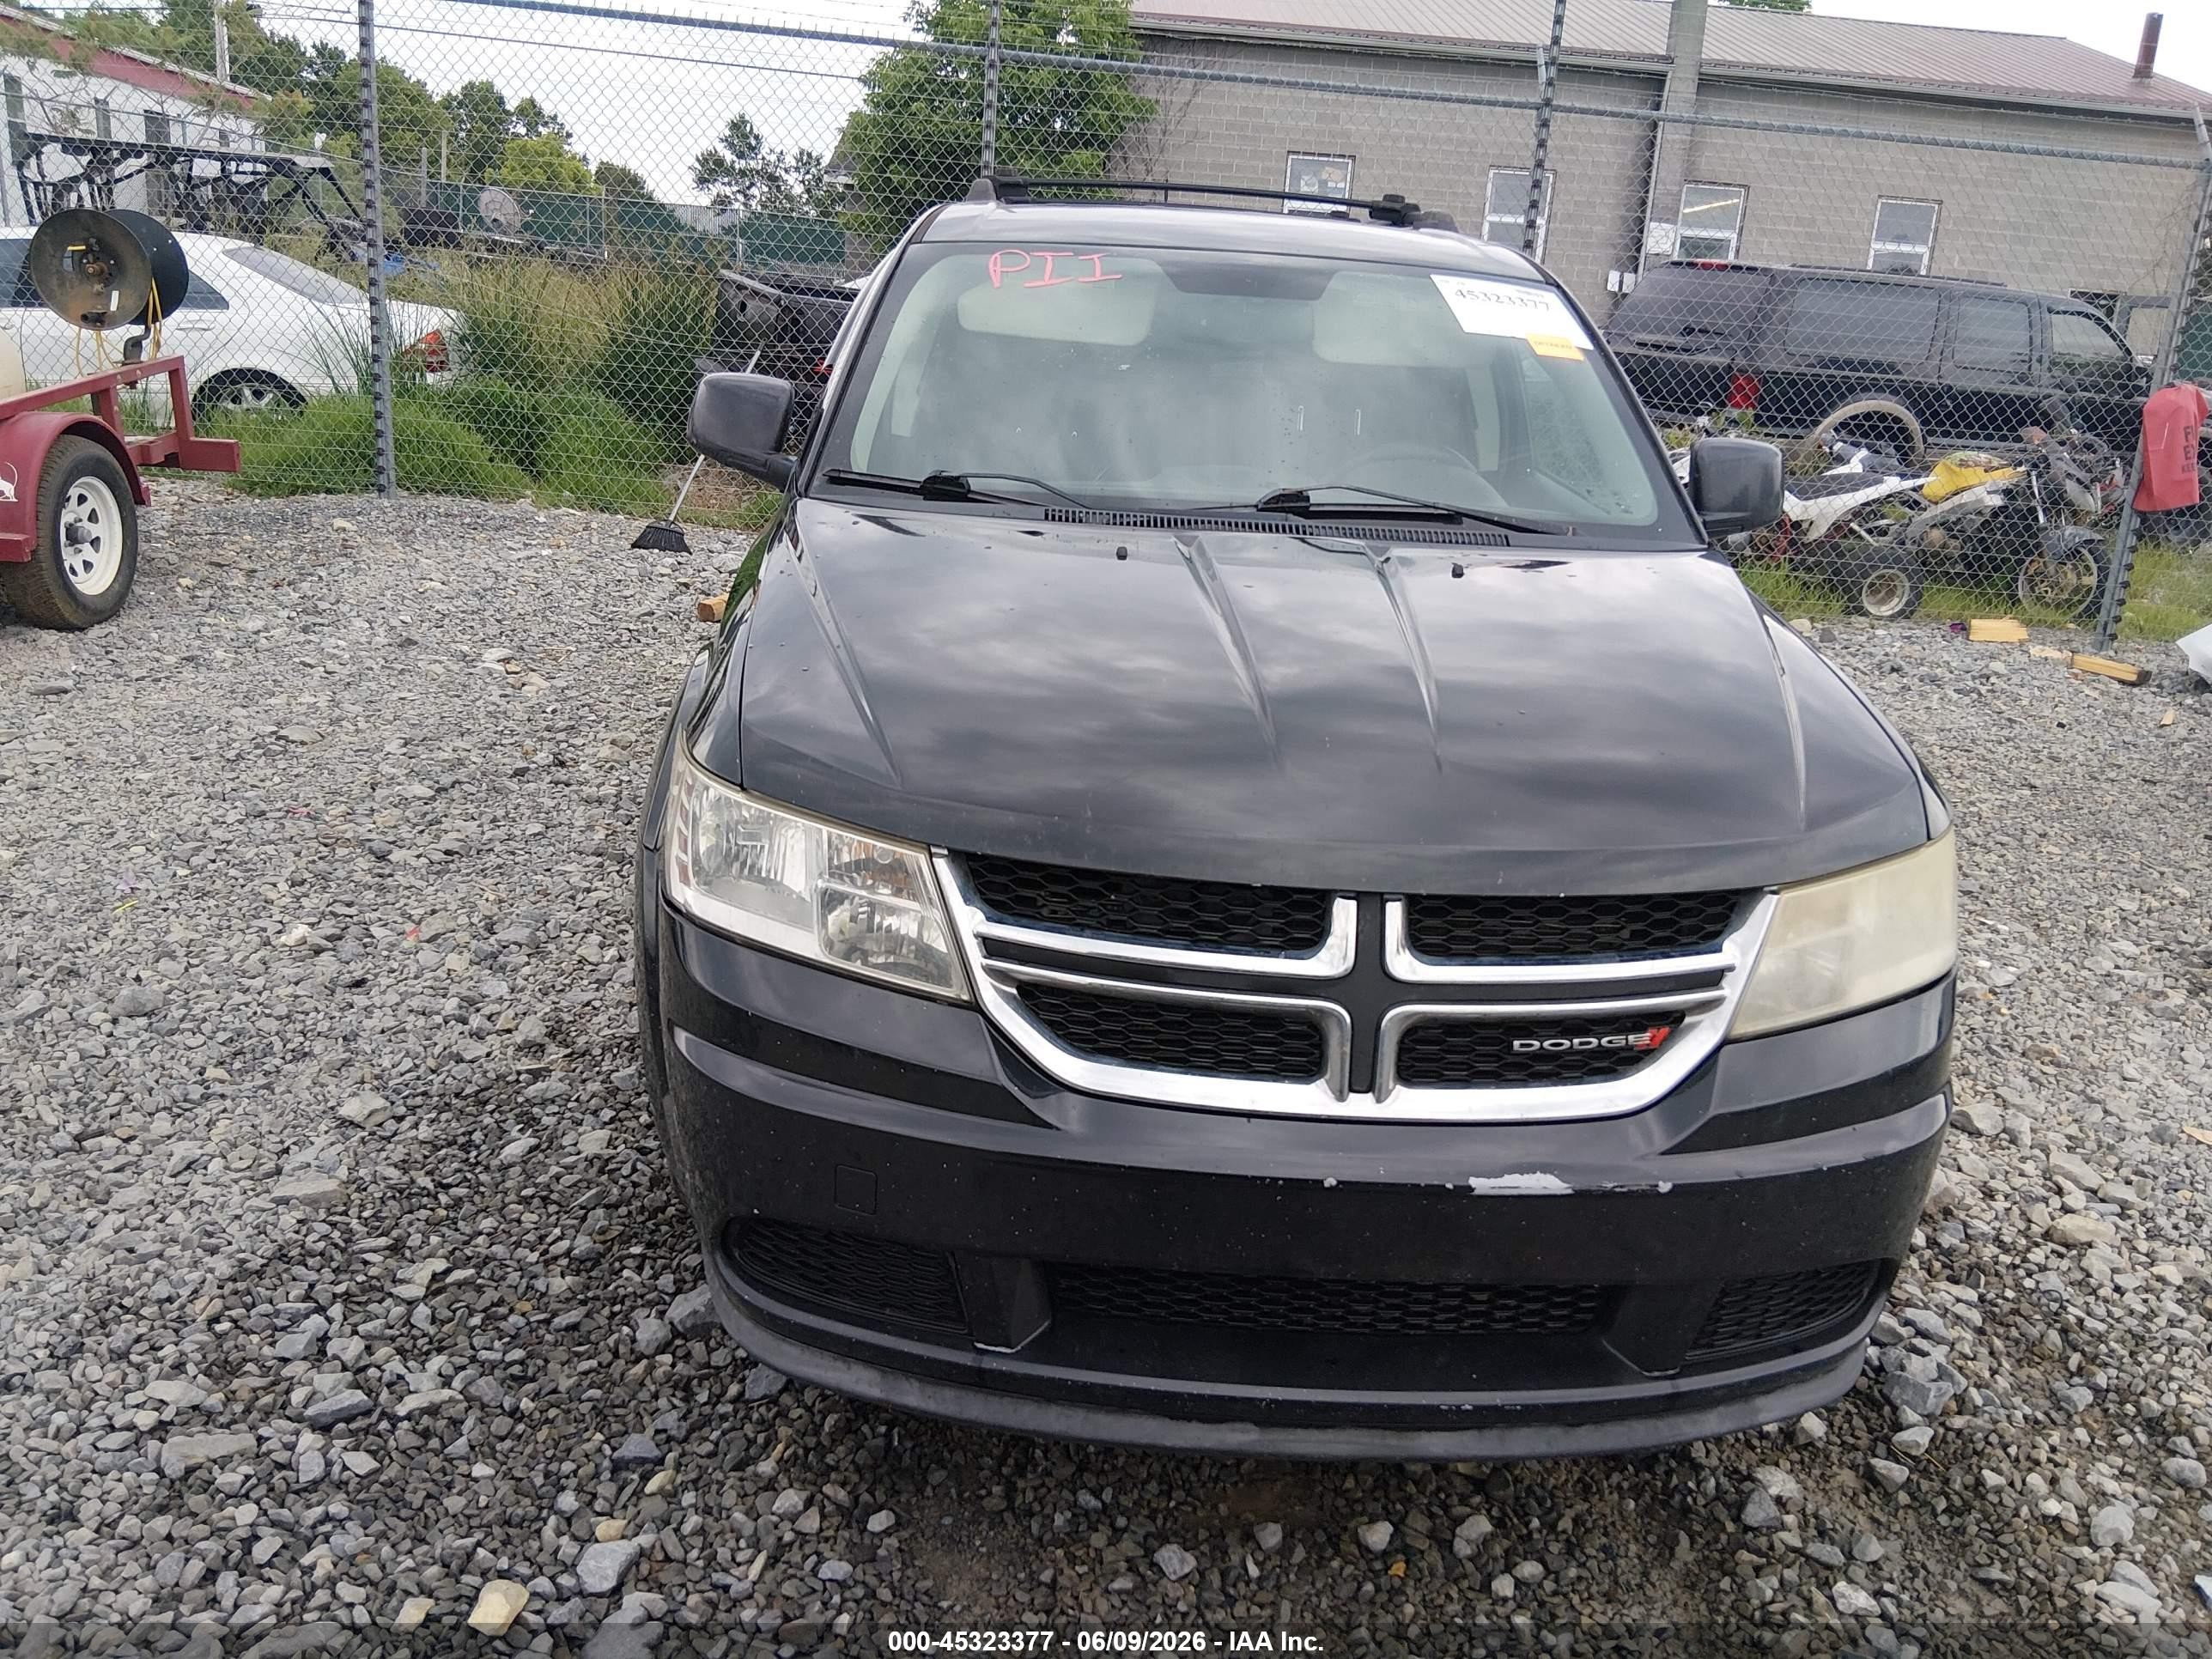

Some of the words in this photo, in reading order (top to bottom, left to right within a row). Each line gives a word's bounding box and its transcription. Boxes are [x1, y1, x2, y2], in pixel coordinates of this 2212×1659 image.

[988, 249, 1123, 289] PII
[1455, 289, 1551, 312] 45323377
[1512, 1032, 1651, 1052] DODGE
